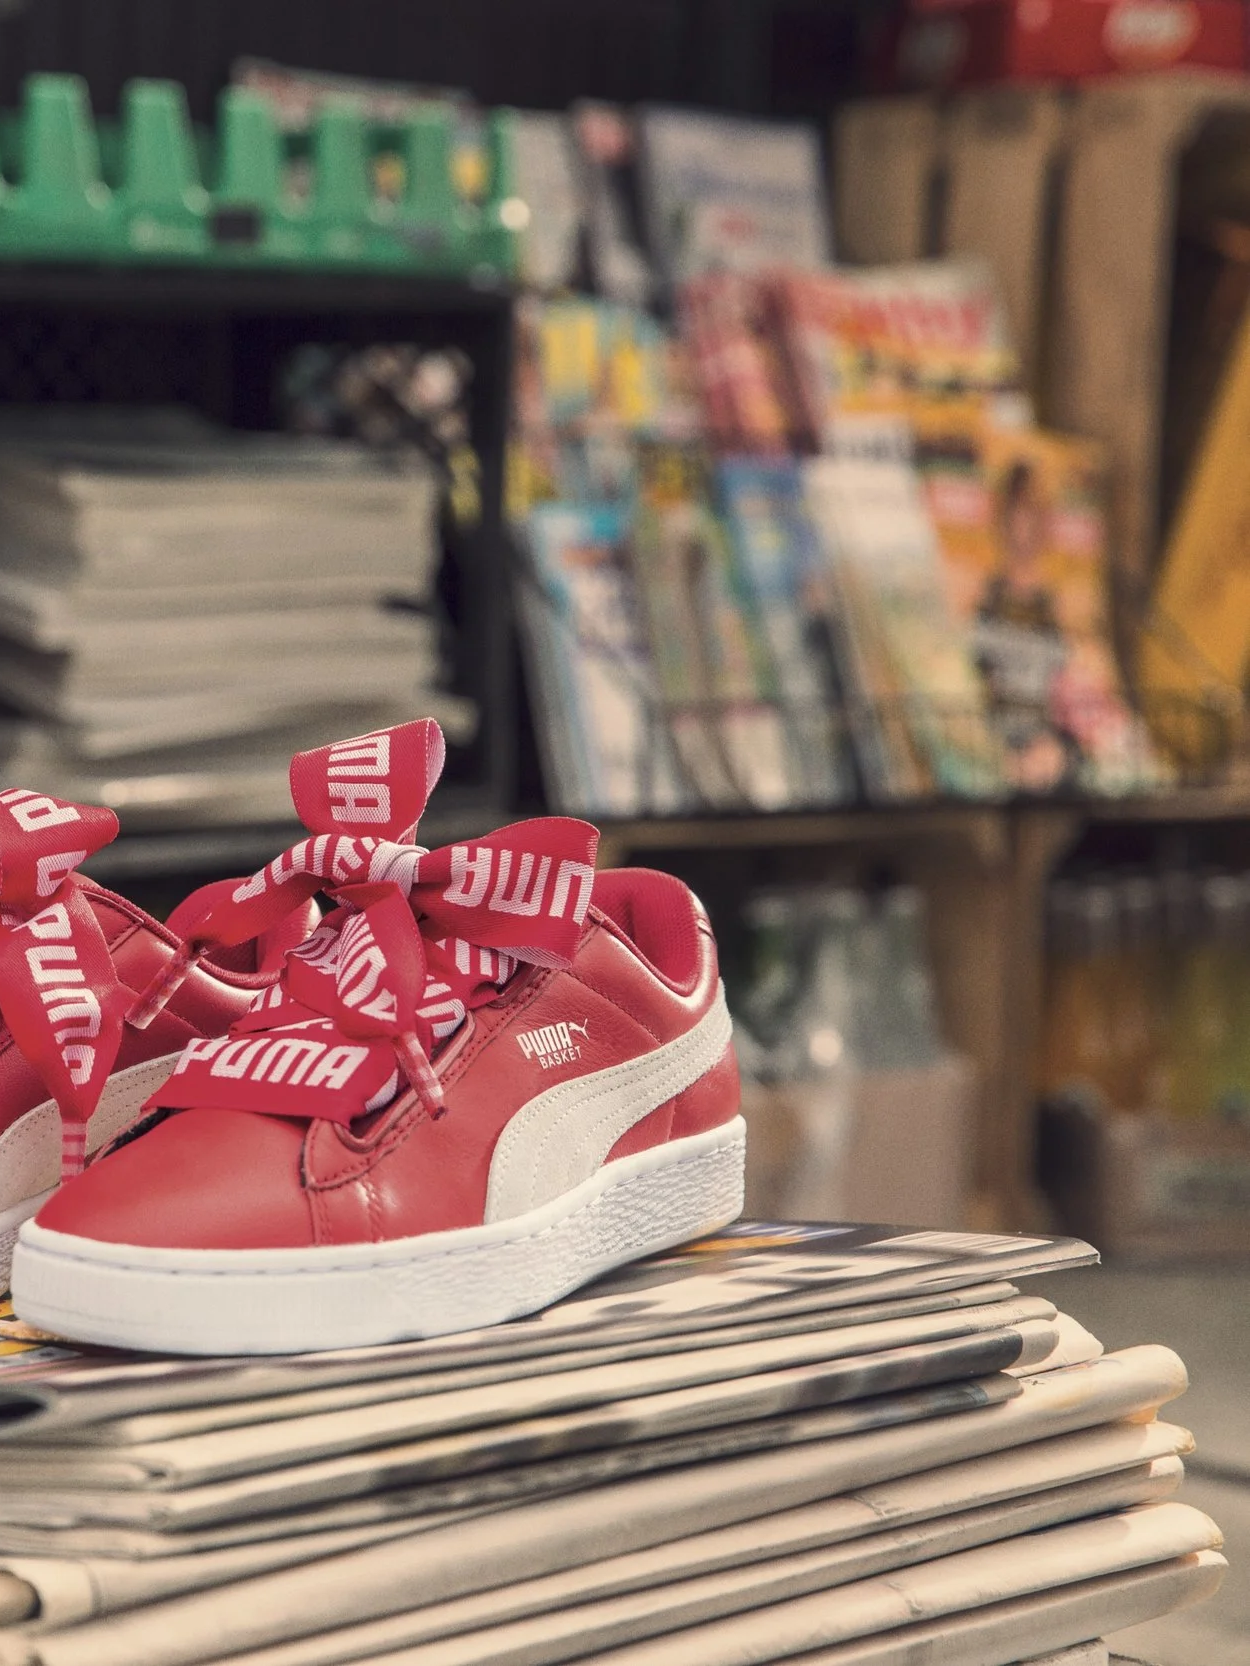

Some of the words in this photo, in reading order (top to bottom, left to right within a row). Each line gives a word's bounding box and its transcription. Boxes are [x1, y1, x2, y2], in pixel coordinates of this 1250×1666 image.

[516, 1021, 573, 1060] PUMA
[538, 1045, 582, 1070] BASKET
[173, 1037, 370, 1090] PUMA
